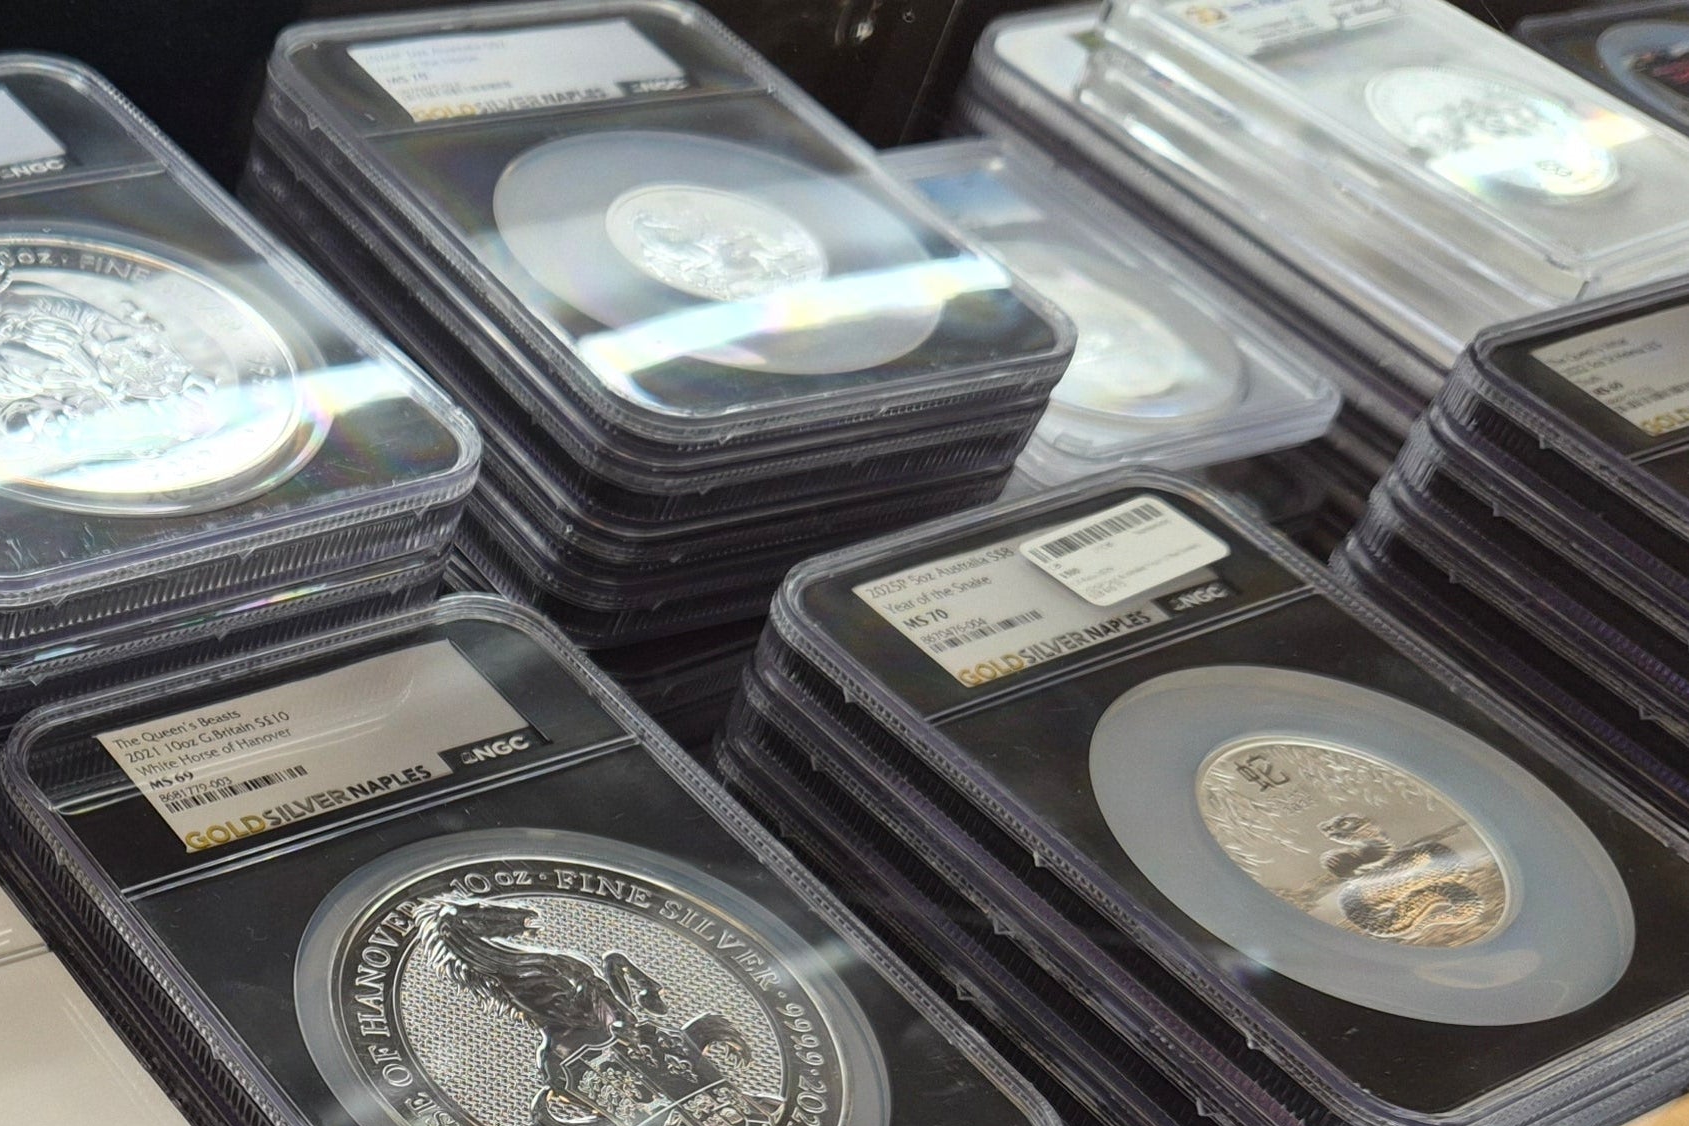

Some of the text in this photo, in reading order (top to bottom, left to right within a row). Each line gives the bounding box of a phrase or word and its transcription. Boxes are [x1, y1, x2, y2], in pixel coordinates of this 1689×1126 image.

[79, 254, 151, 282] FINE
[935, 556, 989, 578] Australia
[882, 575, 992, 615] Year of the Snake
[902, 608, 949, 630] MS 70
[958, 610, 1152, 686] GOLDSILVERNAPLES
[112, 709, 241, 750] The Queen's Beasts
[125, 749, 161, 763] 2021
[165, 738, 199, 753] 10oz
[199, 722, 255, 744] G.Britain
[476, 735, 529, 762] NGC
[135, 728, 292, 777] White Horse of Hanover
[150, 771, 194, 790] MS 69
[185, 765, 432, 852] GOLDSILVERNAPLES
[368, 1045, 413, 1087] OF
[450, 873, 491, 896] 10
[555, 869, 652, 909] FINE
[660, 899, 780, 993] SILVER
